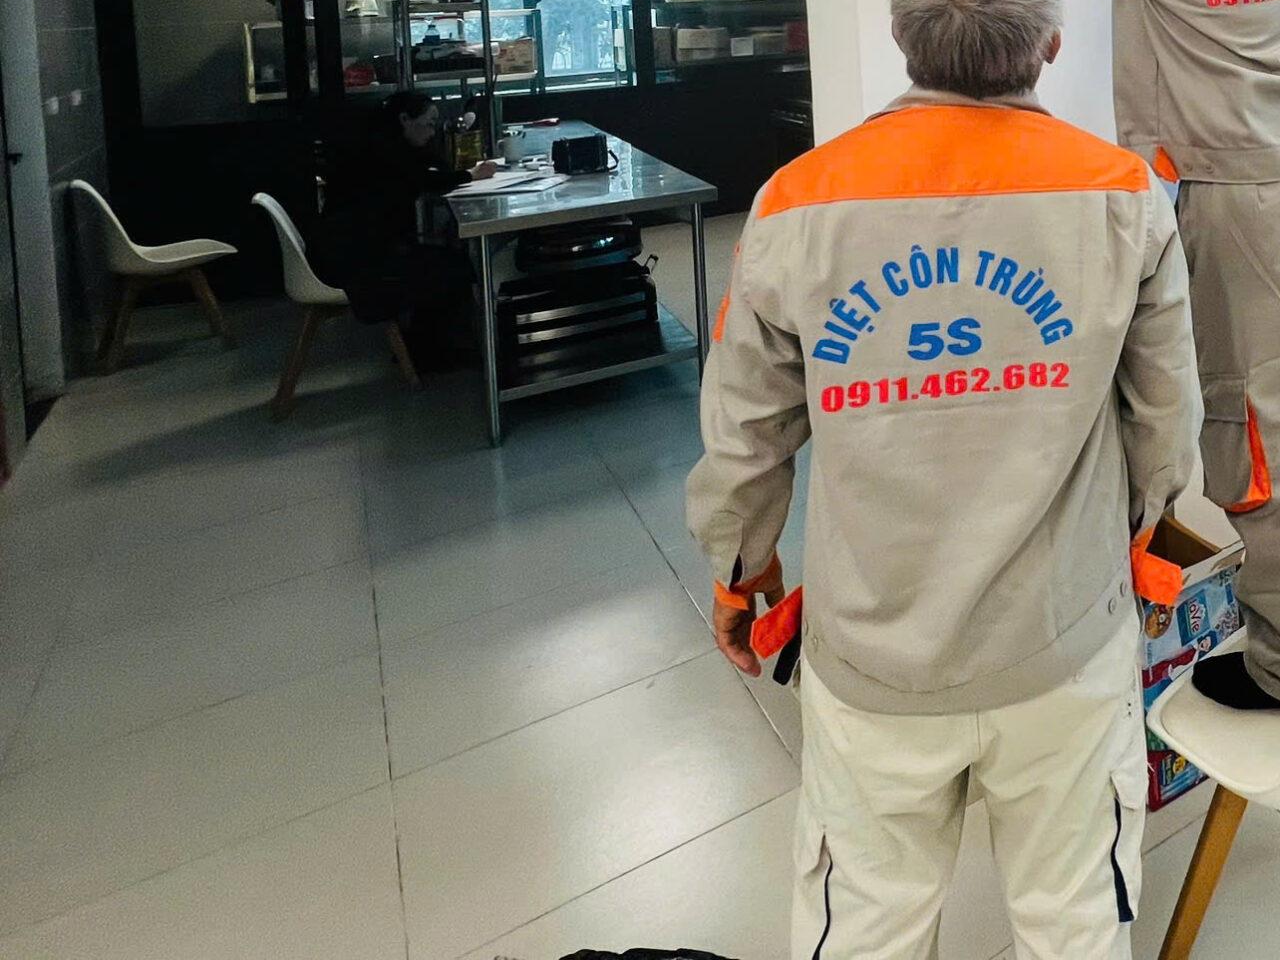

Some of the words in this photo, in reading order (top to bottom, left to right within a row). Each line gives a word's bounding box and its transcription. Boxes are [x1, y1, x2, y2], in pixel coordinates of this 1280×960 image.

[812, 280, 881, 364] DIỆT
[882, 244, 959, 297] CÔN
[975, 249, 1073, 345] TRÙNG
[907, 317, 982, 360] 5S
[820, 362, 1070, 413] 0911.462.682
